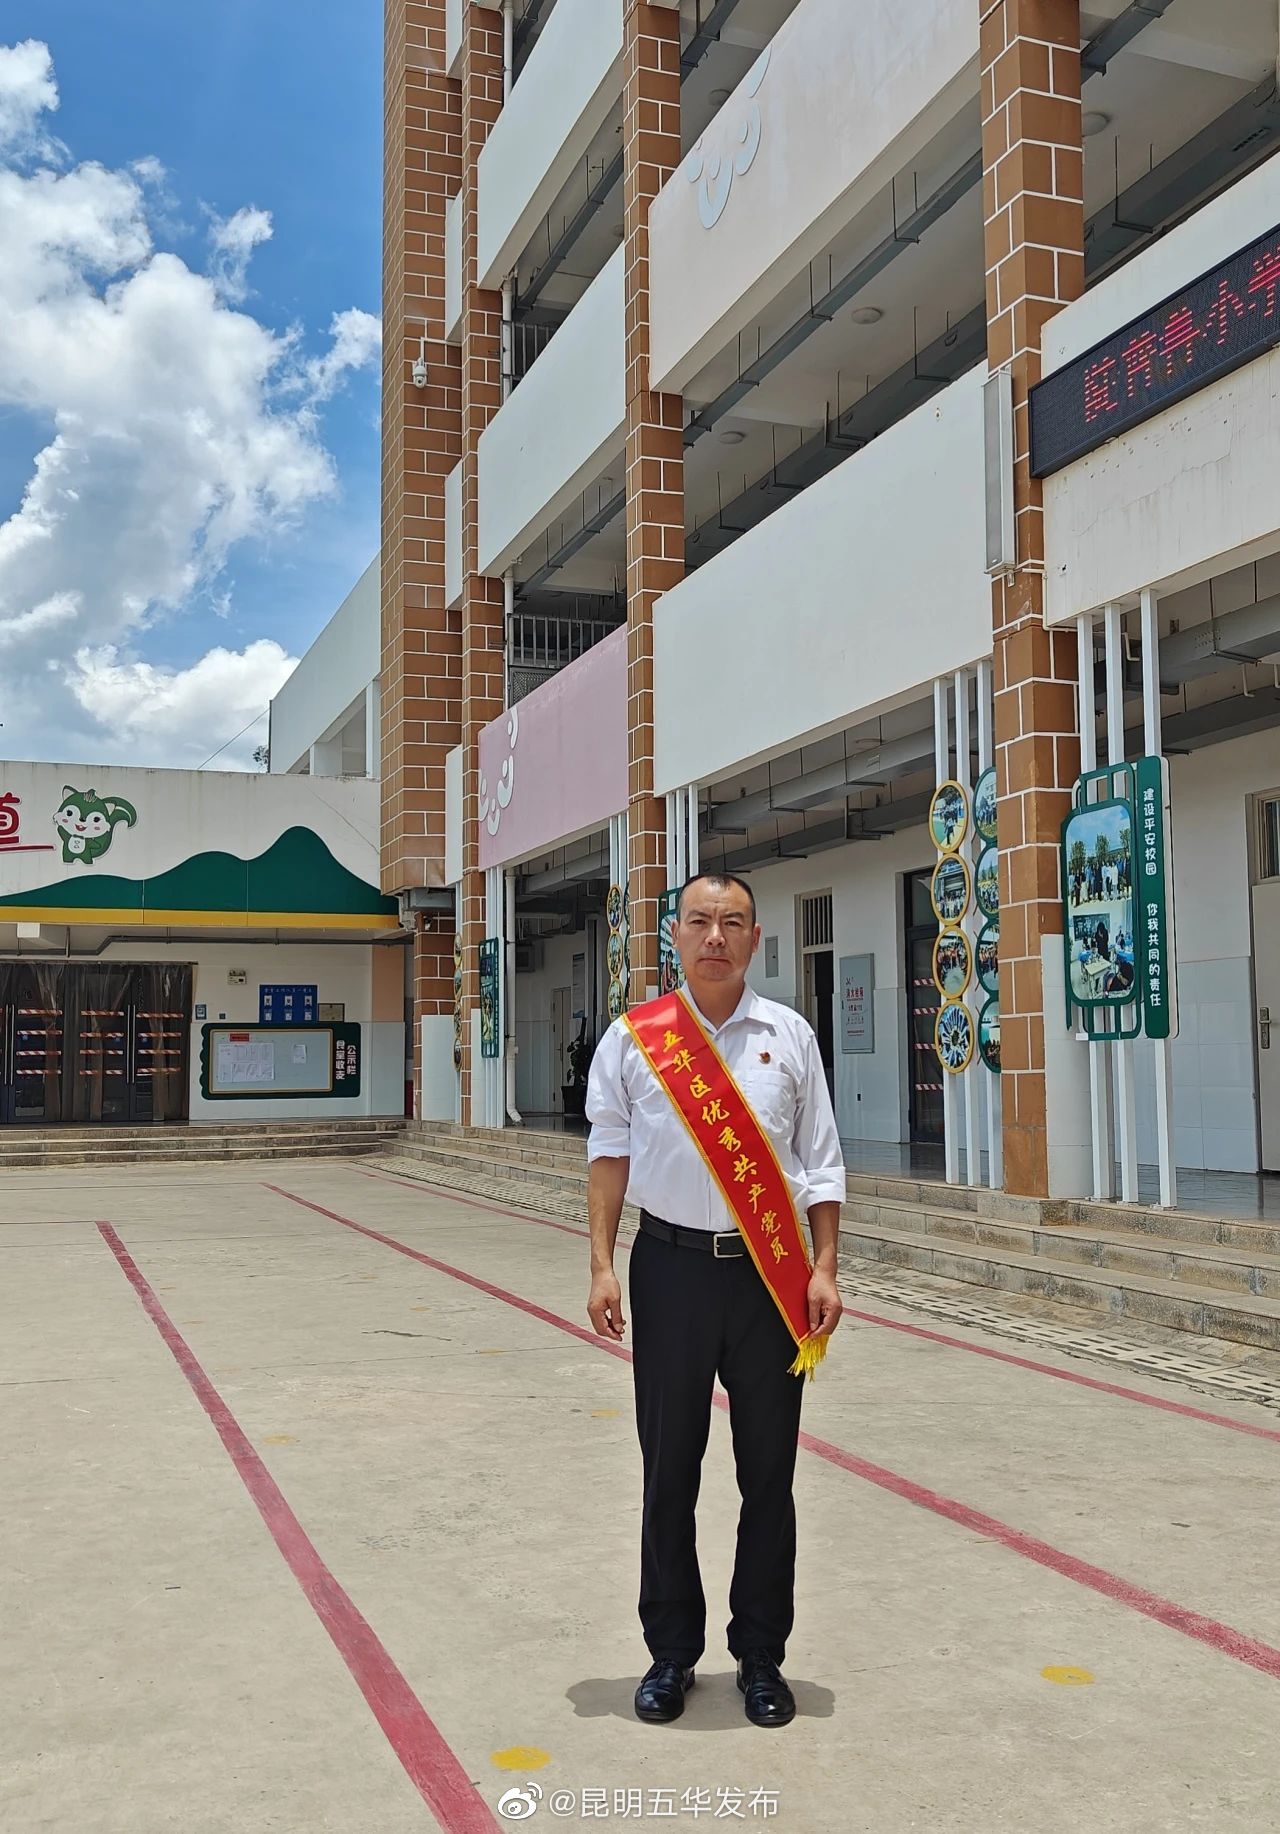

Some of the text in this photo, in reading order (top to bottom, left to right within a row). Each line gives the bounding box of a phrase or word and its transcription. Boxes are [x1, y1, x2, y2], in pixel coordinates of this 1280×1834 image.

[1143, 787, 1157, 876] 建设平安校园
[1146, 902, 1161, 1007] 你我共同的责任
[335, 1039, 346, 1080] 食堂收支
[346, 1044, 357, 1075] 公示栏
[662, 1029, 789, 1265] 五华区优秀共产党员
